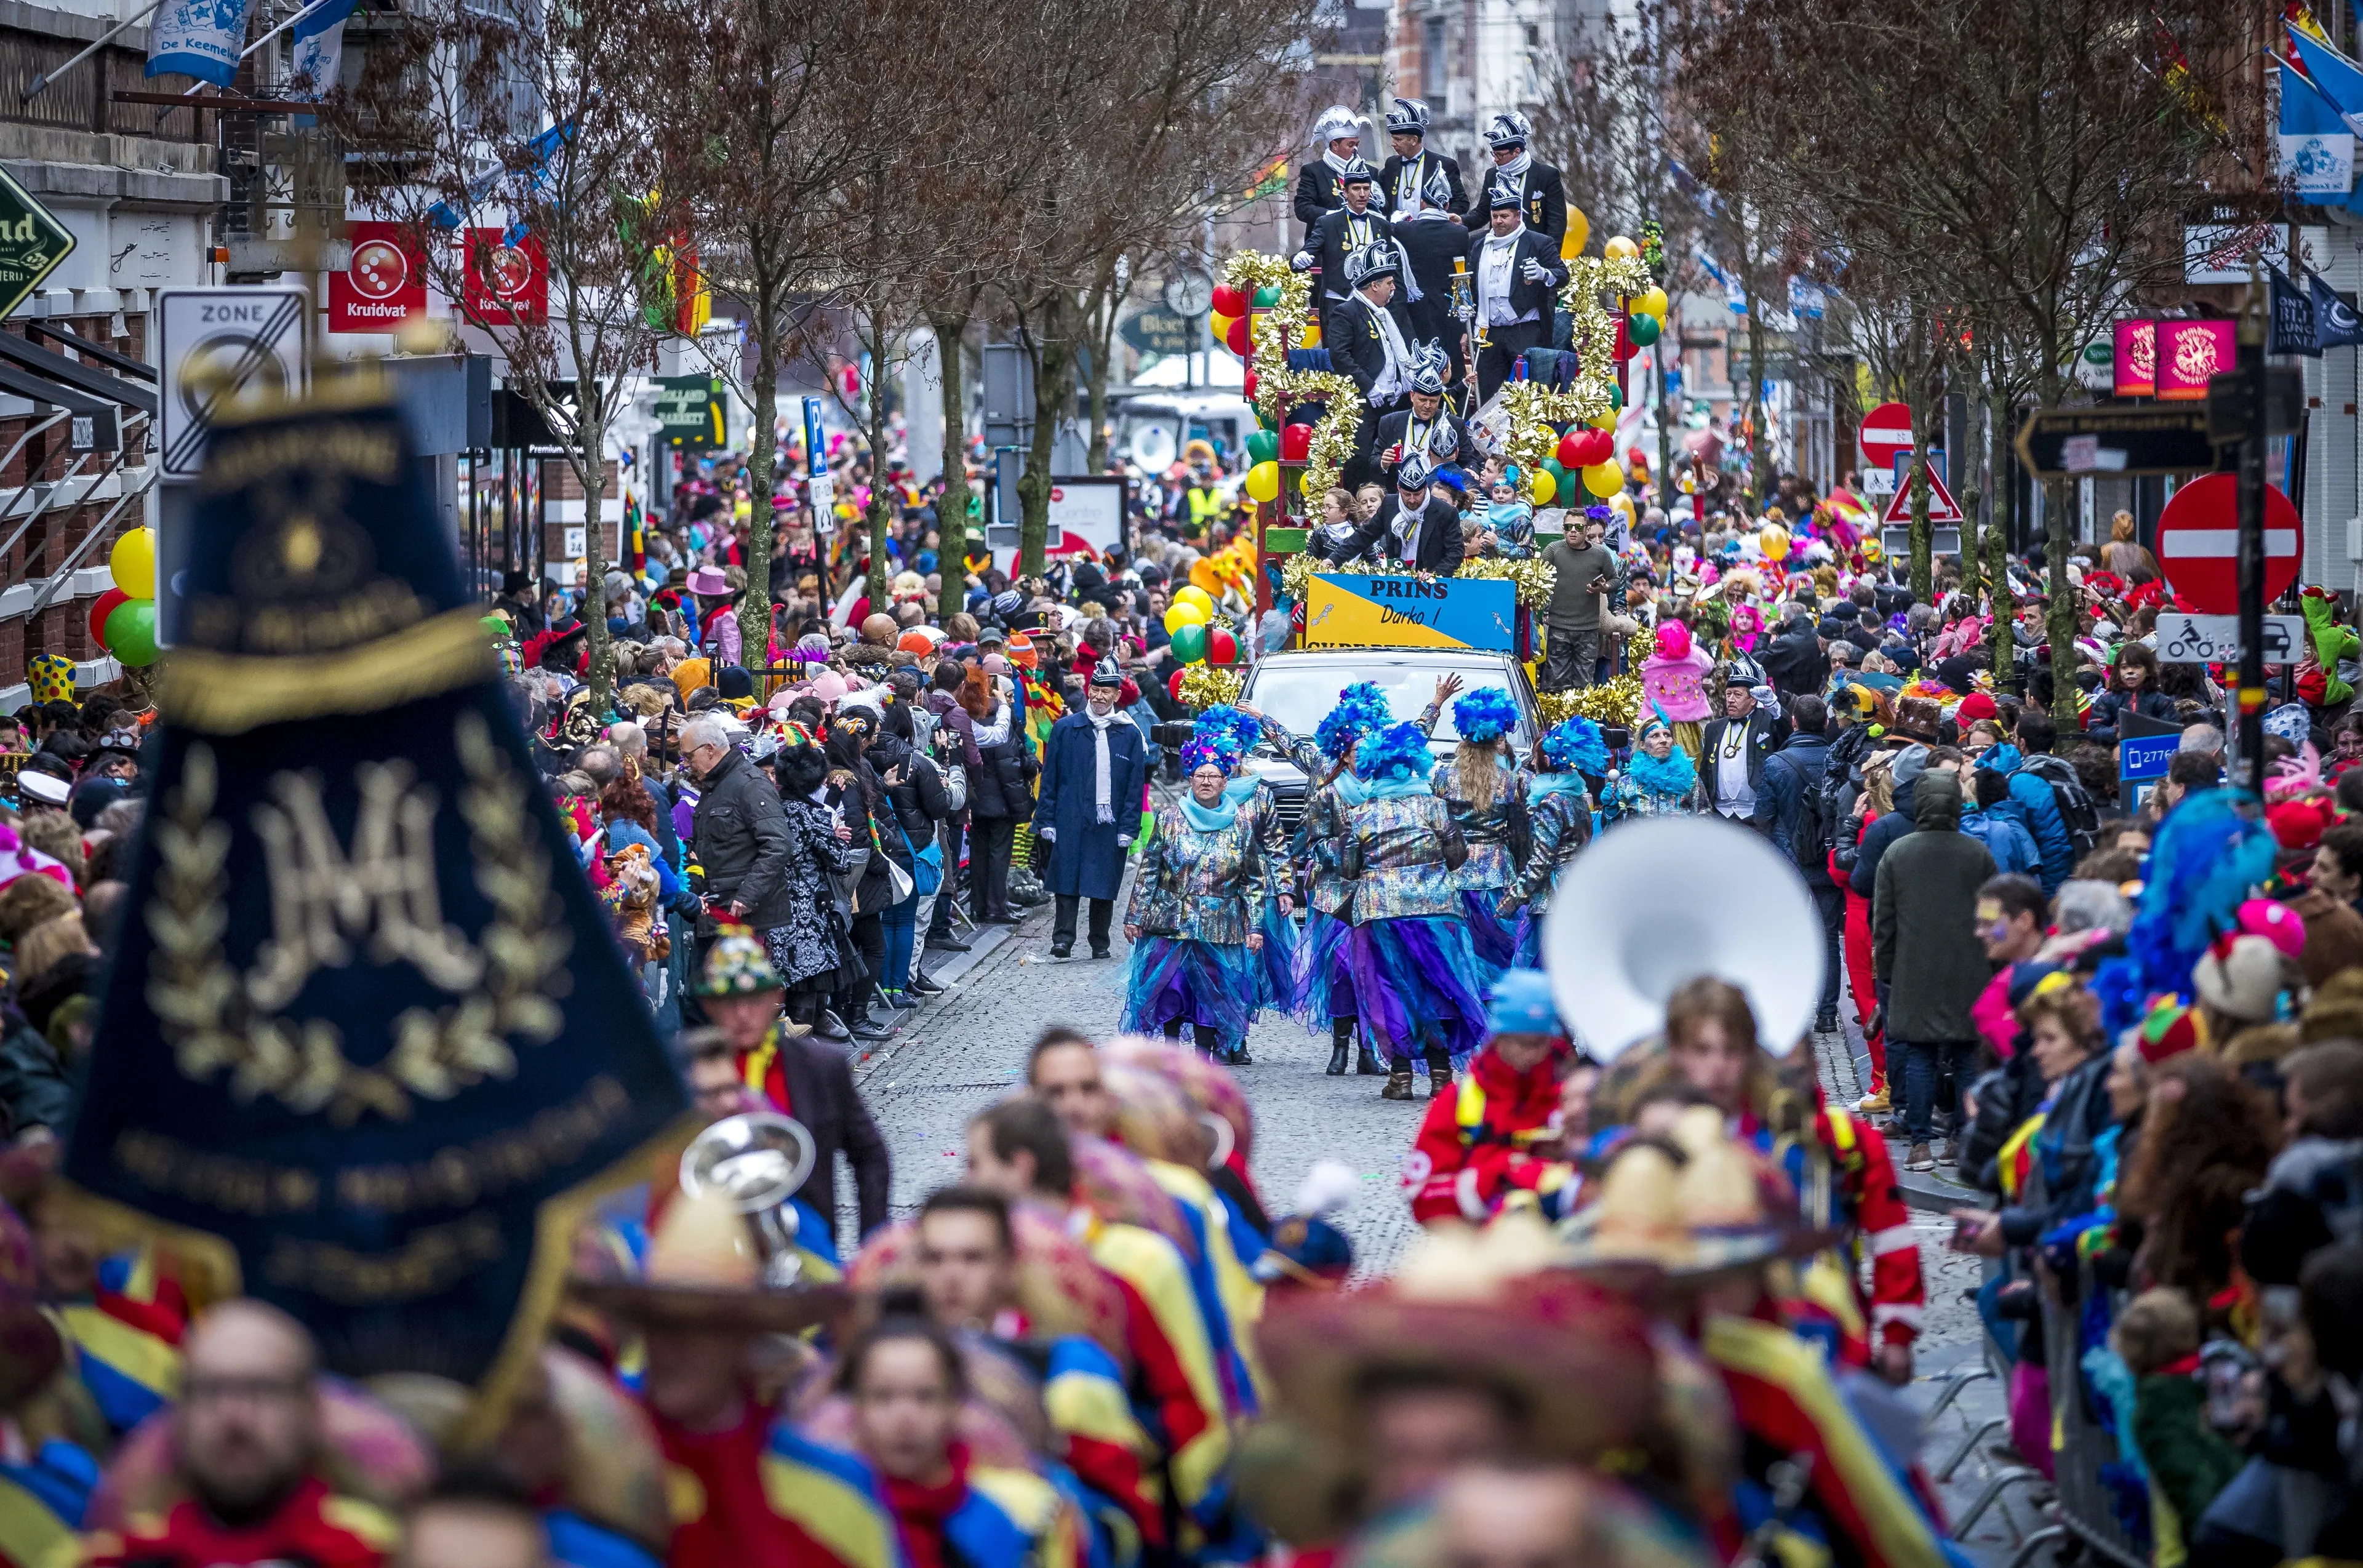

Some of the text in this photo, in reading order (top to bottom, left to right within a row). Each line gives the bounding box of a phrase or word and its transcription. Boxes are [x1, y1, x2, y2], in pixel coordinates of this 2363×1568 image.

[161, 41, 178, 50] De
[348, 303, 406, 317] Kruidvat
[480, 298, 529, 311] Kruvat
[201, 305, 263, 321] ZONE
[529, 444, 564, 454] Premium
[1370, 580, 1448, 600] PRINS
[1380, 604, 1425, 625] Darko
